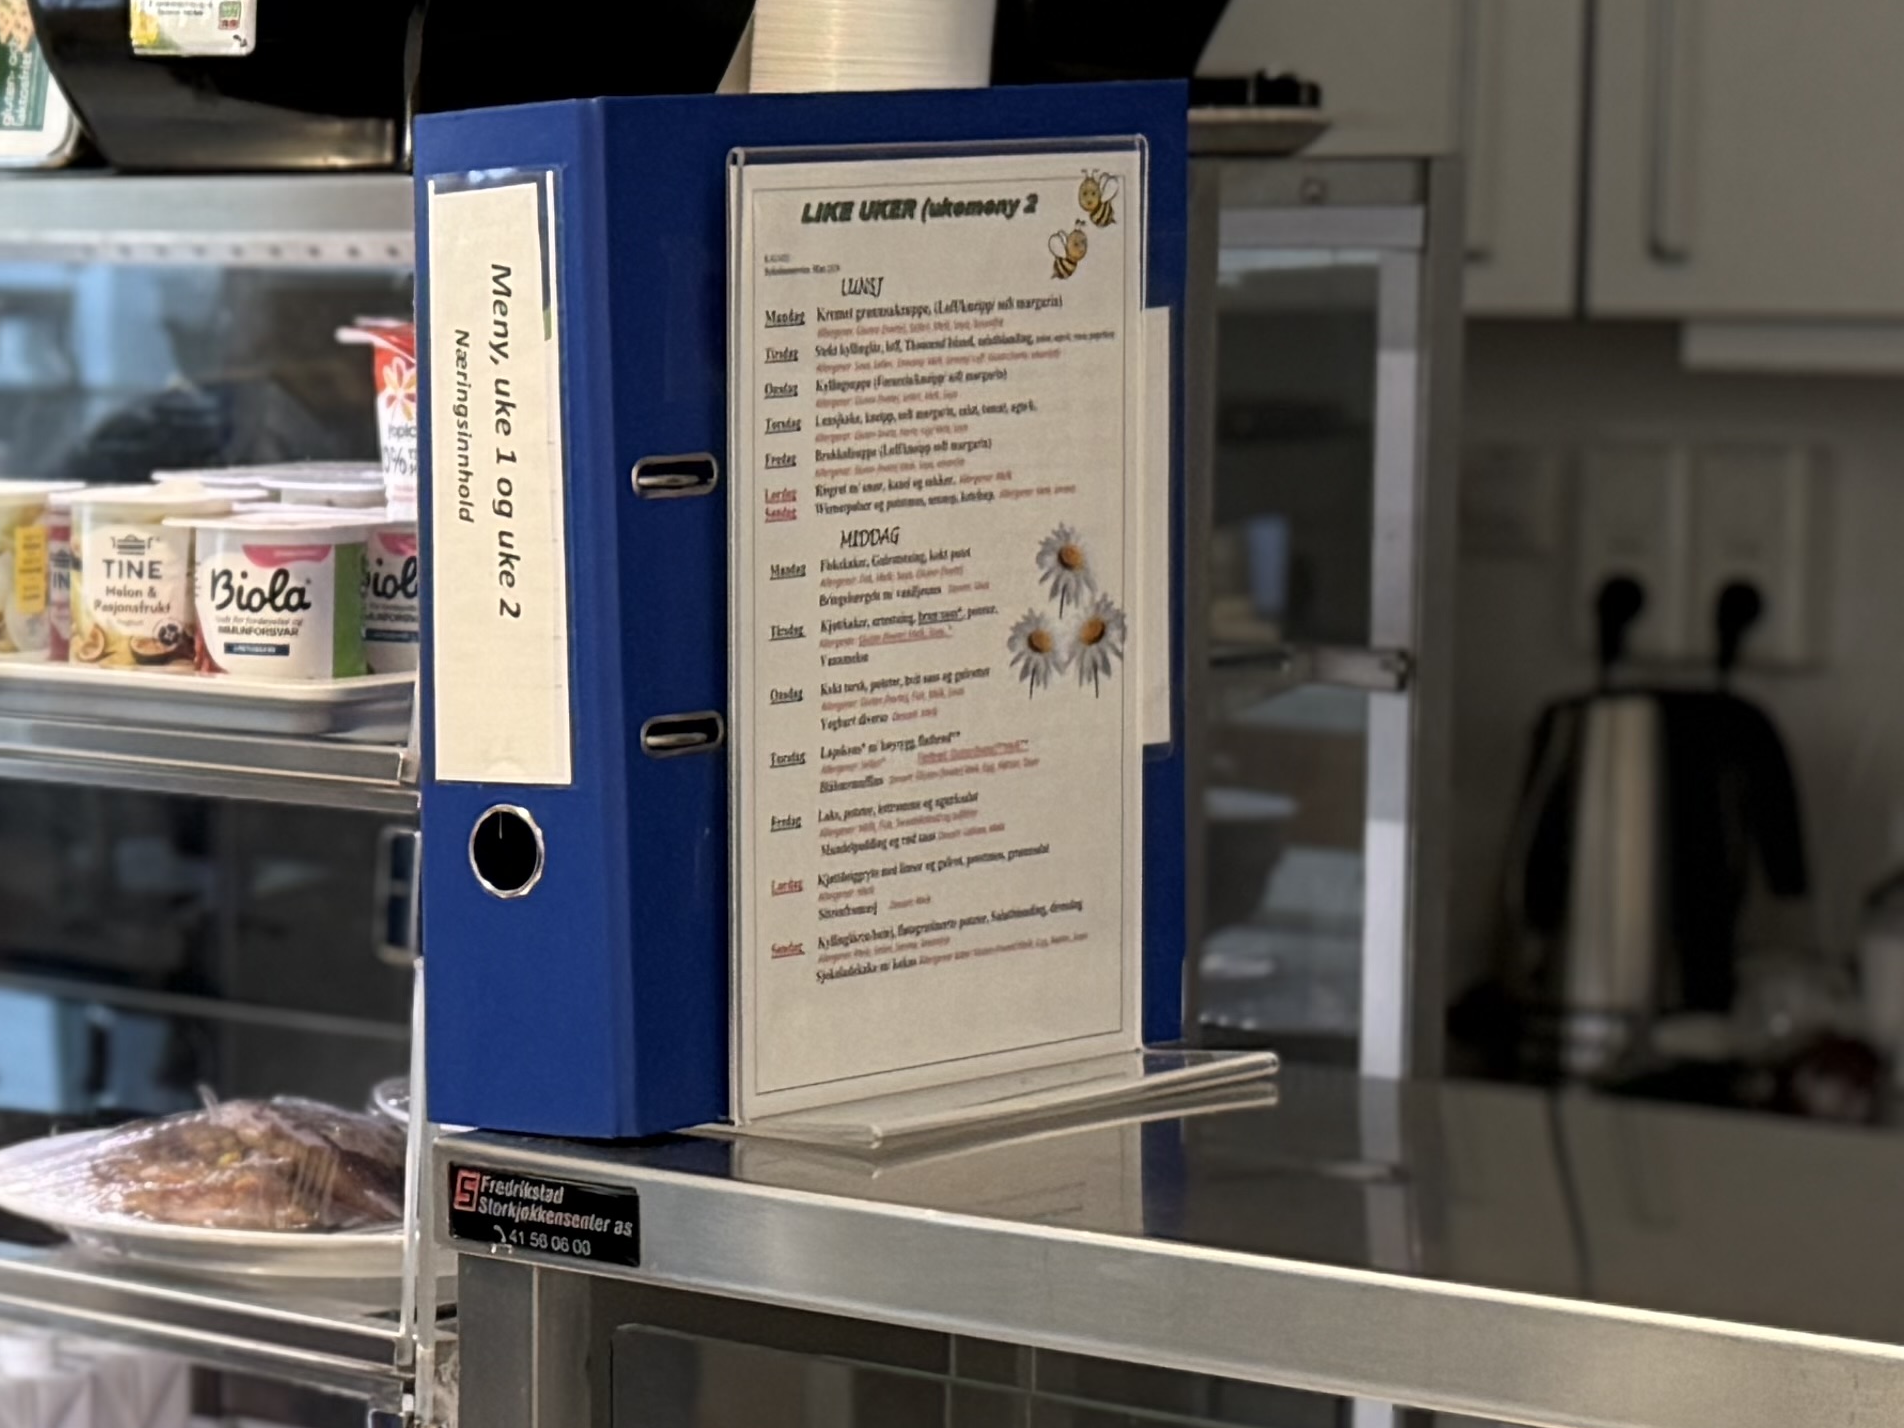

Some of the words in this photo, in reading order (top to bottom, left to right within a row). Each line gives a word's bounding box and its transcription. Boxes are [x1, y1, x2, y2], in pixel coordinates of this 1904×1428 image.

[800, 201, 855, 223] LIKE
[858, 198, 917, 222] UKER
[1023, 193, 1039, 213] 2
[488, 263, 513, 365] Meny,
[494, 378, 517, 436] uke
[452, 329, 475, 523] Næringsinnhold
[496, 447, 517, 464] 1
[492, 477, 513, 518] og
[840, 526, 901, 549] MIDDAG
[102, 559, 163, 580] TINE
[498, 530, 521, 588] uke
[210, 568, 312, 613] Biola
[499, 598, 521, 619] 2
[480, 1174, 565, 1205] Fredrikstad
[613, 1220, 633, 1238] as
[572, 1239, 592, 1256] 00
